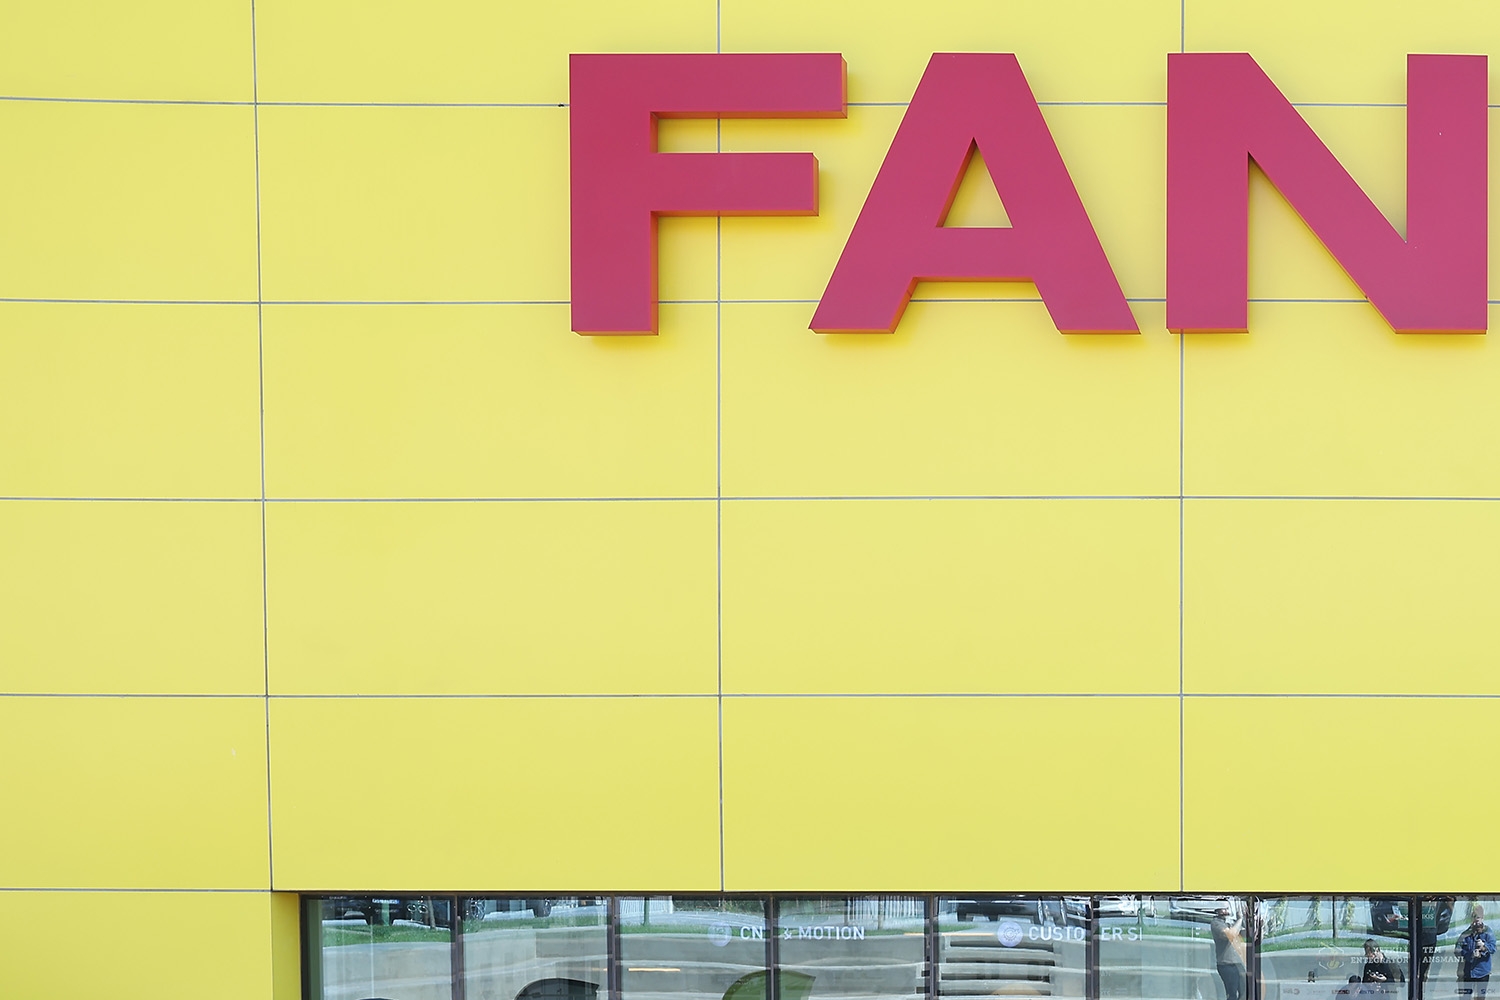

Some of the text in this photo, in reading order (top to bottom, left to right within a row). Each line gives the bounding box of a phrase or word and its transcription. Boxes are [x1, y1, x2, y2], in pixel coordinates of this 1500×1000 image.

[799, 926, 865, 940] MOTION
[1028, 926, 1123, 941] CUSTOER
[1422, 955, 1465, 963] ANSMANI
